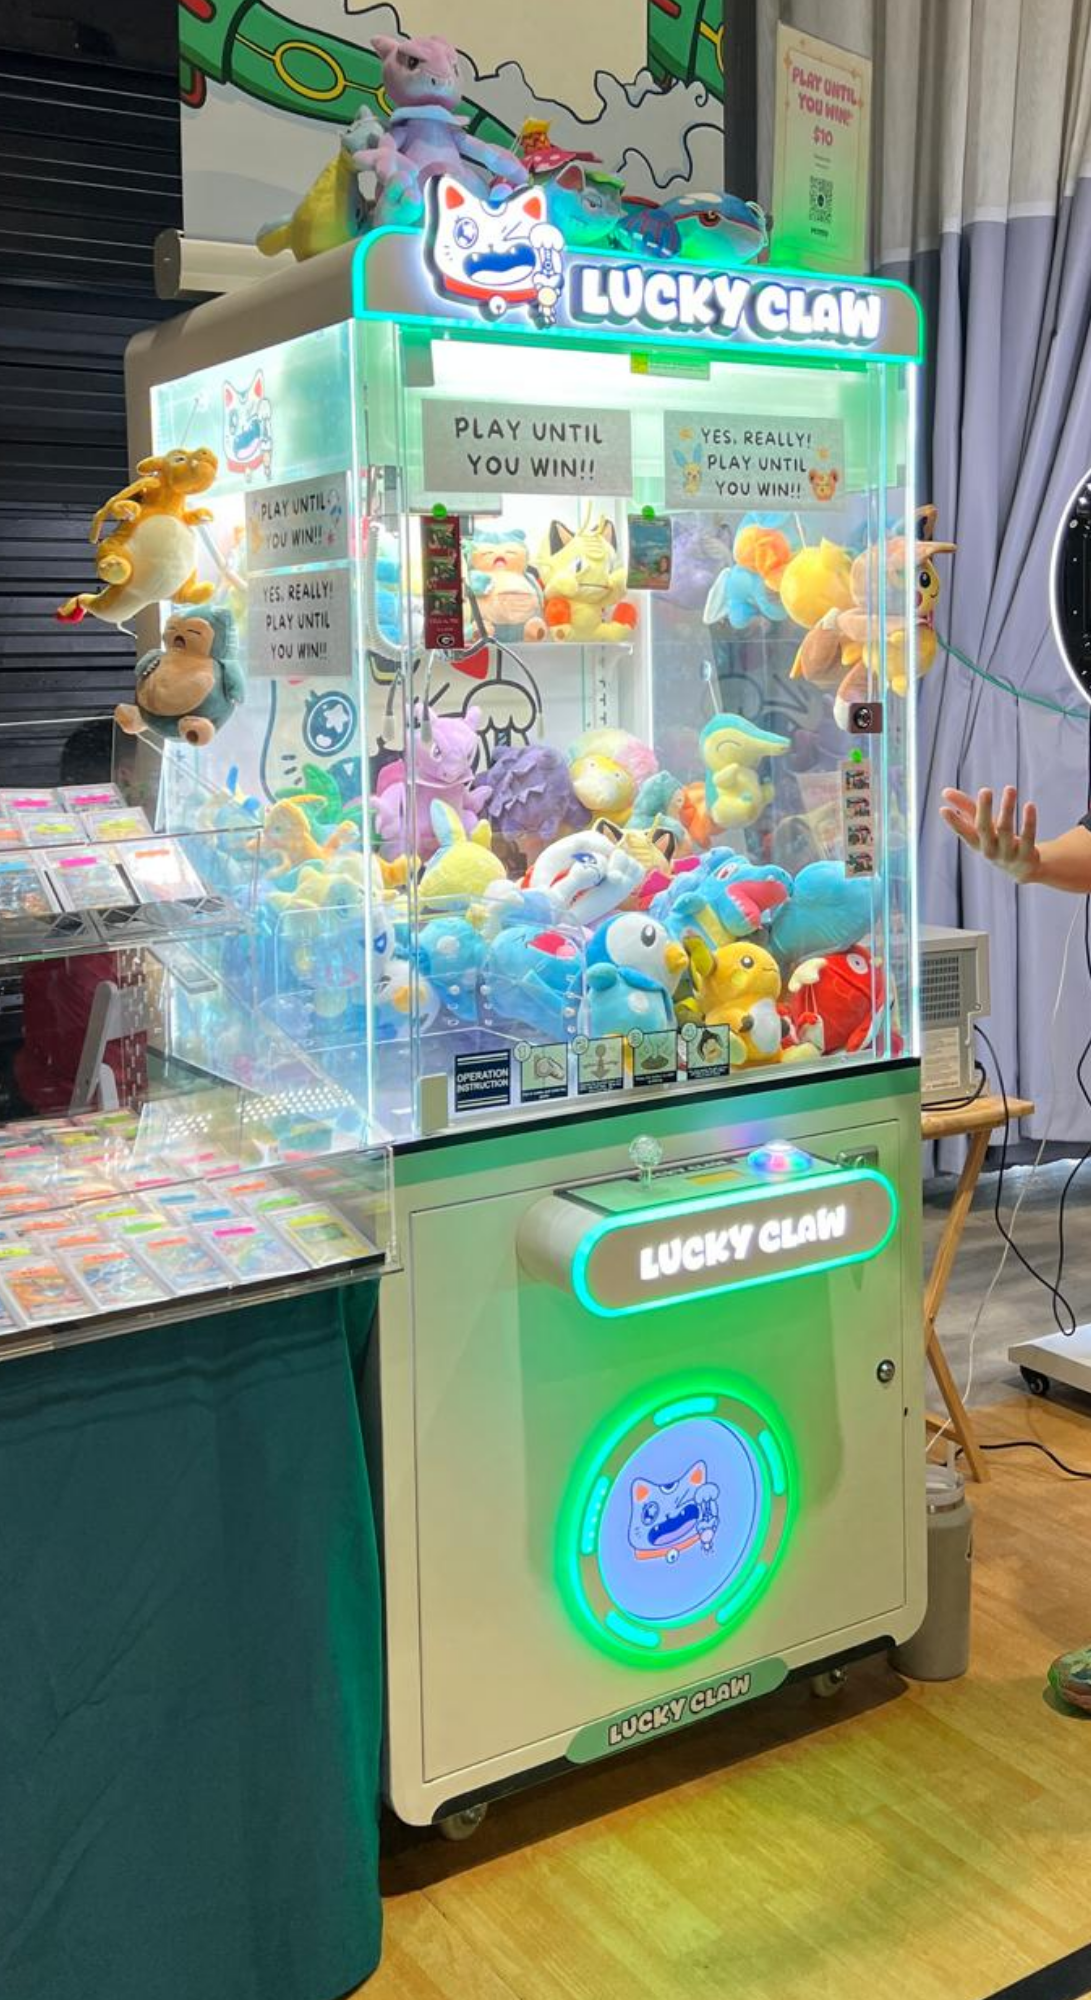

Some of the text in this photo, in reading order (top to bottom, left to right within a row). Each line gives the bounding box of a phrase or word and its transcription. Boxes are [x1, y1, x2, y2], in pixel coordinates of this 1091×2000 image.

[792, 67, 857, 106] PLAY UNTIL
[798, 92, 823, 116] YOU
[813, 125, 833, 146] $10
[579, 264, 882, 341] LUCKY CLAW
[454, 416, 603, 444] PLAY UNTIL
[743, 430, 812, 449] REALLY!
[467, 453, 595, 481] YOU WIN!!
[707, 453, 807, 473] PLAY UNTIL
[715, 480, 801, 499] YOU WIN!!
[260, 492, 326, 522] PLAY UNTIL
[265, 524, 322, 550] YOU WIN!!
[288, 579, 334, 601] REALLY!
[265, 610, 331, 631] PLAY UNTIL
[270, 641, 327, 661] YOU WIN!!
[456, 1067, 509, 1083] OPERATION
[457, 1078, 509, 1093] INSTRUCTION
[639, 1203, 847, 1281] LUCKY CLAW
[608, 1673, 751, 1746] LUCKY CLAW
